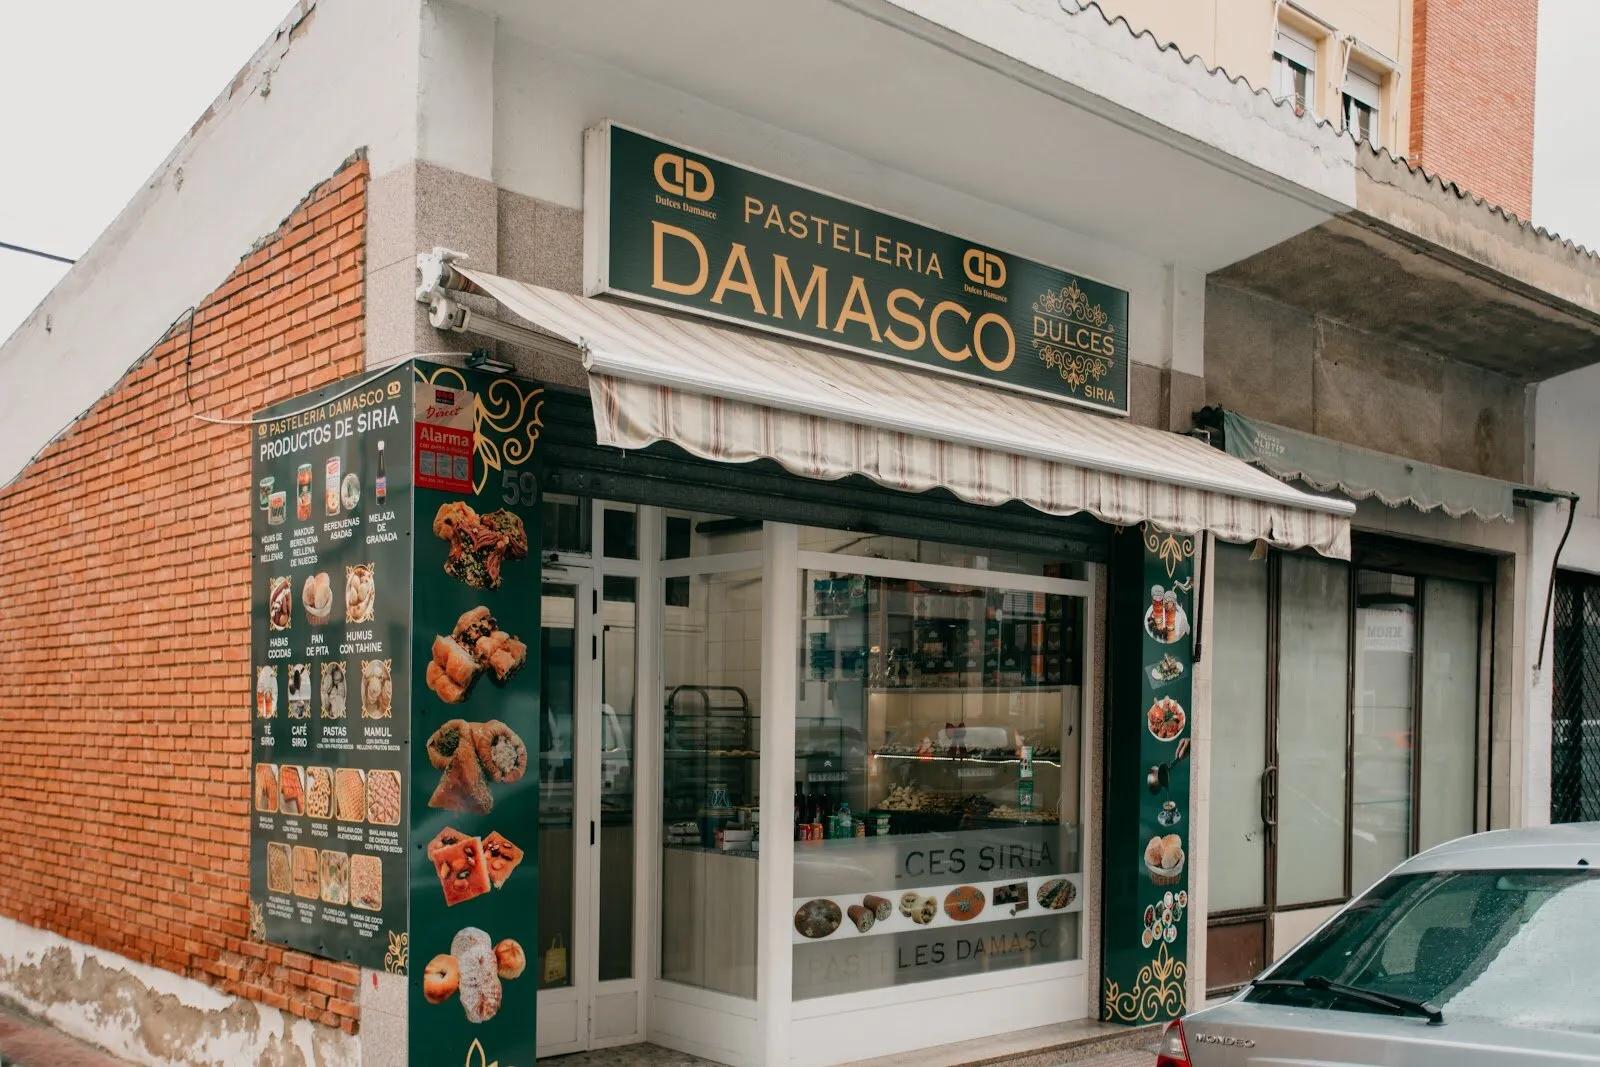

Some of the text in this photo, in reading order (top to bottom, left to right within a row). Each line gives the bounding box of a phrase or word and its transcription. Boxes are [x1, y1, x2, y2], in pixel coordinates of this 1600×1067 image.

[655, 194, 681, 210] Dulces
[744, 195, 944, 280] PASTELERIA
[964, 283, 982, 296] Dulces
[651, 220, 1016, 372] DAMASCO
[1033, 315, 1115, 356] DULCES
[1084, 383, 1116, 403] SIRIA
[269, 408, 325, 437] PASTELERIA
[329, 389, 384, 418] DAMASCO
[260, 405, 399, 462] PRODUCTOS DE SIRIA
[420, 427, 469, 447] Alarma
[502, 469, 537, 506] 59
[369, 511, 395, 523] MELAZA
[324, 517, 360, 532] BERENJENAS
[377, 523, 386, 532] DE
[330, 529, 352, 541] ASADAS
[366, 532, 397, 544] GRANADA
[312, 634, 323, 644] PAN
[346, 630, 372, 641] HUMUS
[270, 637, 288, 647] HABAS
[340, 642, 382, 654] CON TAHINE
[268, 649, 291, 659] COCIDAS
[306, 646, 329, 656] DE PITA
[292, 722, 307, 735] CAFÉ
[323, 726, 347, 736] PASTAS
[364, 727, 392, 737] MAMUL
[261, 736, 275, 746] SIRIO
[292, 737, 307, 747] SIRIO
[979, 840, 1055, 872] SIRIA
[1196, 1032, 1256, 1048] MONDEO
